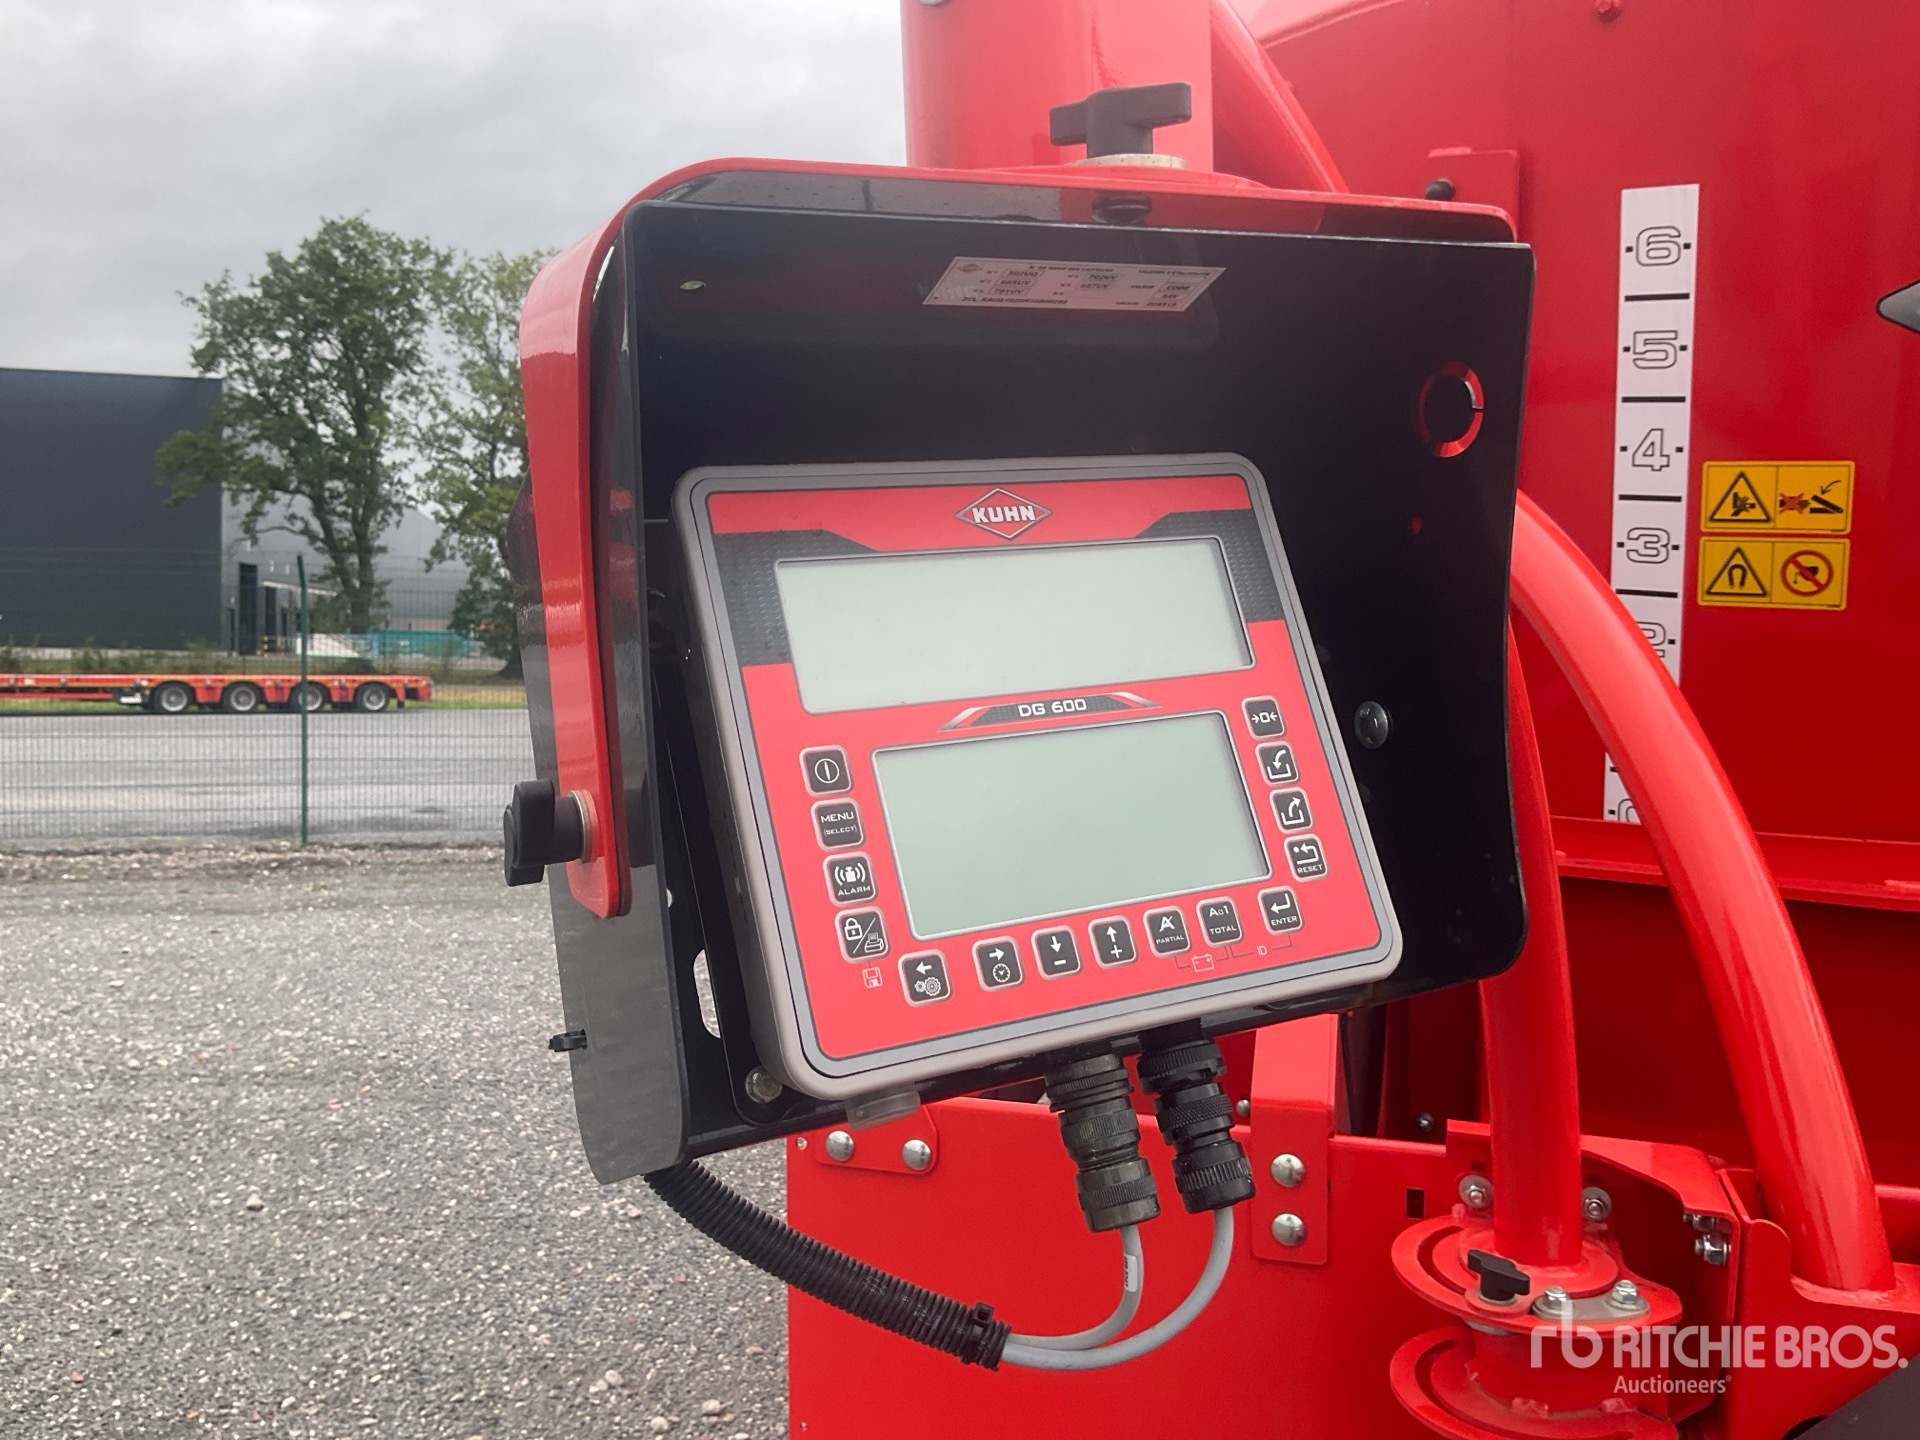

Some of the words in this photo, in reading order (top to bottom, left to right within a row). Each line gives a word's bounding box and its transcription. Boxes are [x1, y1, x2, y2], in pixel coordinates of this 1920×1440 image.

[1635, 225, 1681, 267] 6
[1632, 330, 1678, 369] 5
[1631, 428, 1670, 472] 4
[972, 506, 1036, 523] KUHN
[1626, 526, 1671, 564] 3
[1018, 704, 1046, 717] DG
[1052, 699, 1087, 713] 600
[821, 812, 854, 823] MENU
[1298, 865, 1323, 874] RESET
[838, 885, 871, 896] ALARM
[1272, 916, 1298, 926] ENTER
[1209, 925, 1237, 935] TOTAL
[1155, 935, 1184, 944] PARTIAL
[1256, 946, 1268, 956] ID
